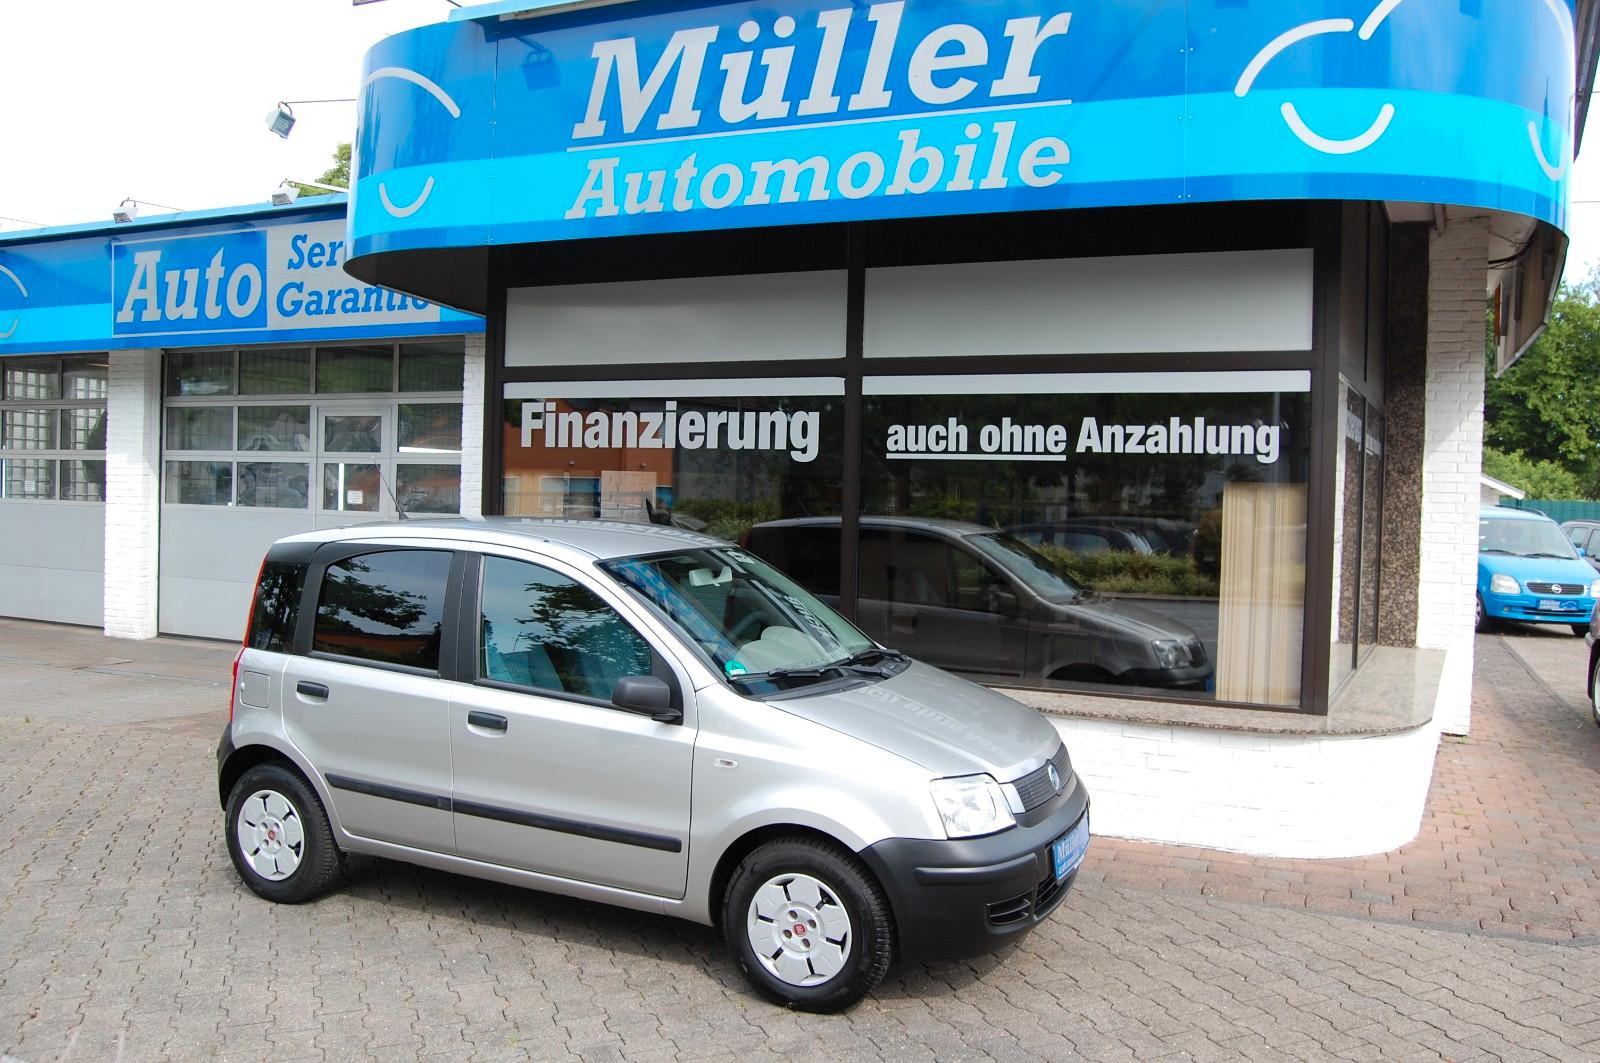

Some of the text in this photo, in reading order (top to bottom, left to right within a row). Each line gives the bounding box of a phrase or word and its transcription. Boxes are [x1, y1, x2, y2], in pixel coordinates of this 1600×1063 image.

[572, 1, 1072, 140] Müller
[564, 121, 1072, 220] Automobile
[116, 247, 263, 323] Auto
[287, 234, 344, 270] Ser
[520, 401, 820, 463] Finanzierung
[886, 416, 1279, 464] auch ohne Anzahlung
